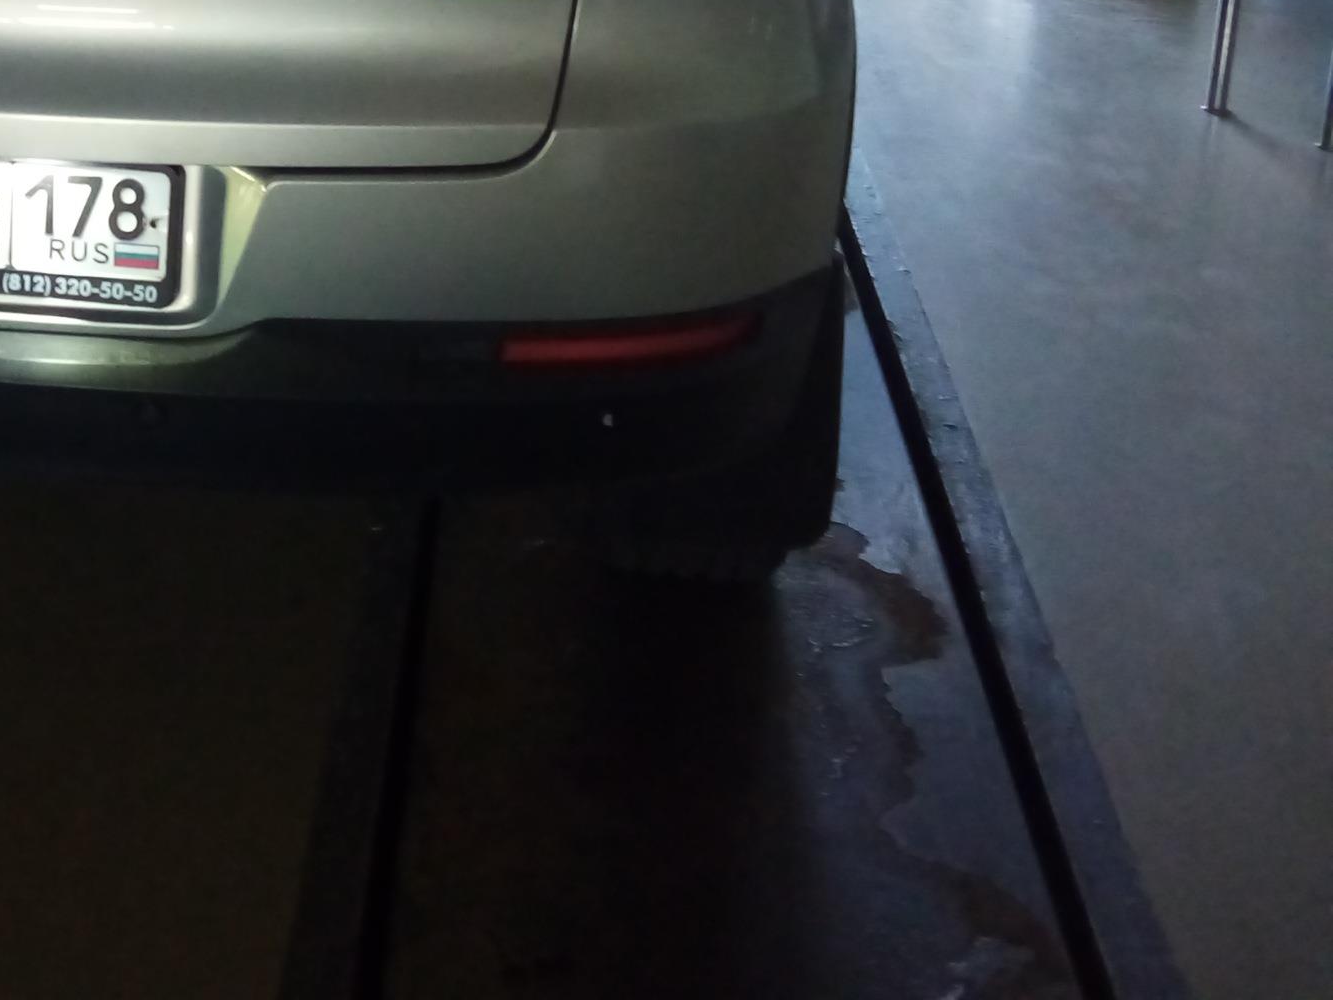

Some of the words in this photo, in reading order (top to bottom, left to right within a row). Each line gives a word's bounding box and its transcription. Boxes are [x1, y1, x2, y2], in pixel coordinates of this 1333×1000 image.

[24, 174, 147, 241] 178
[47, 237, 110, 265] RUS
[1, 272, 52, 297] (812)
[54, 278, 158, 304] 320-50-50
